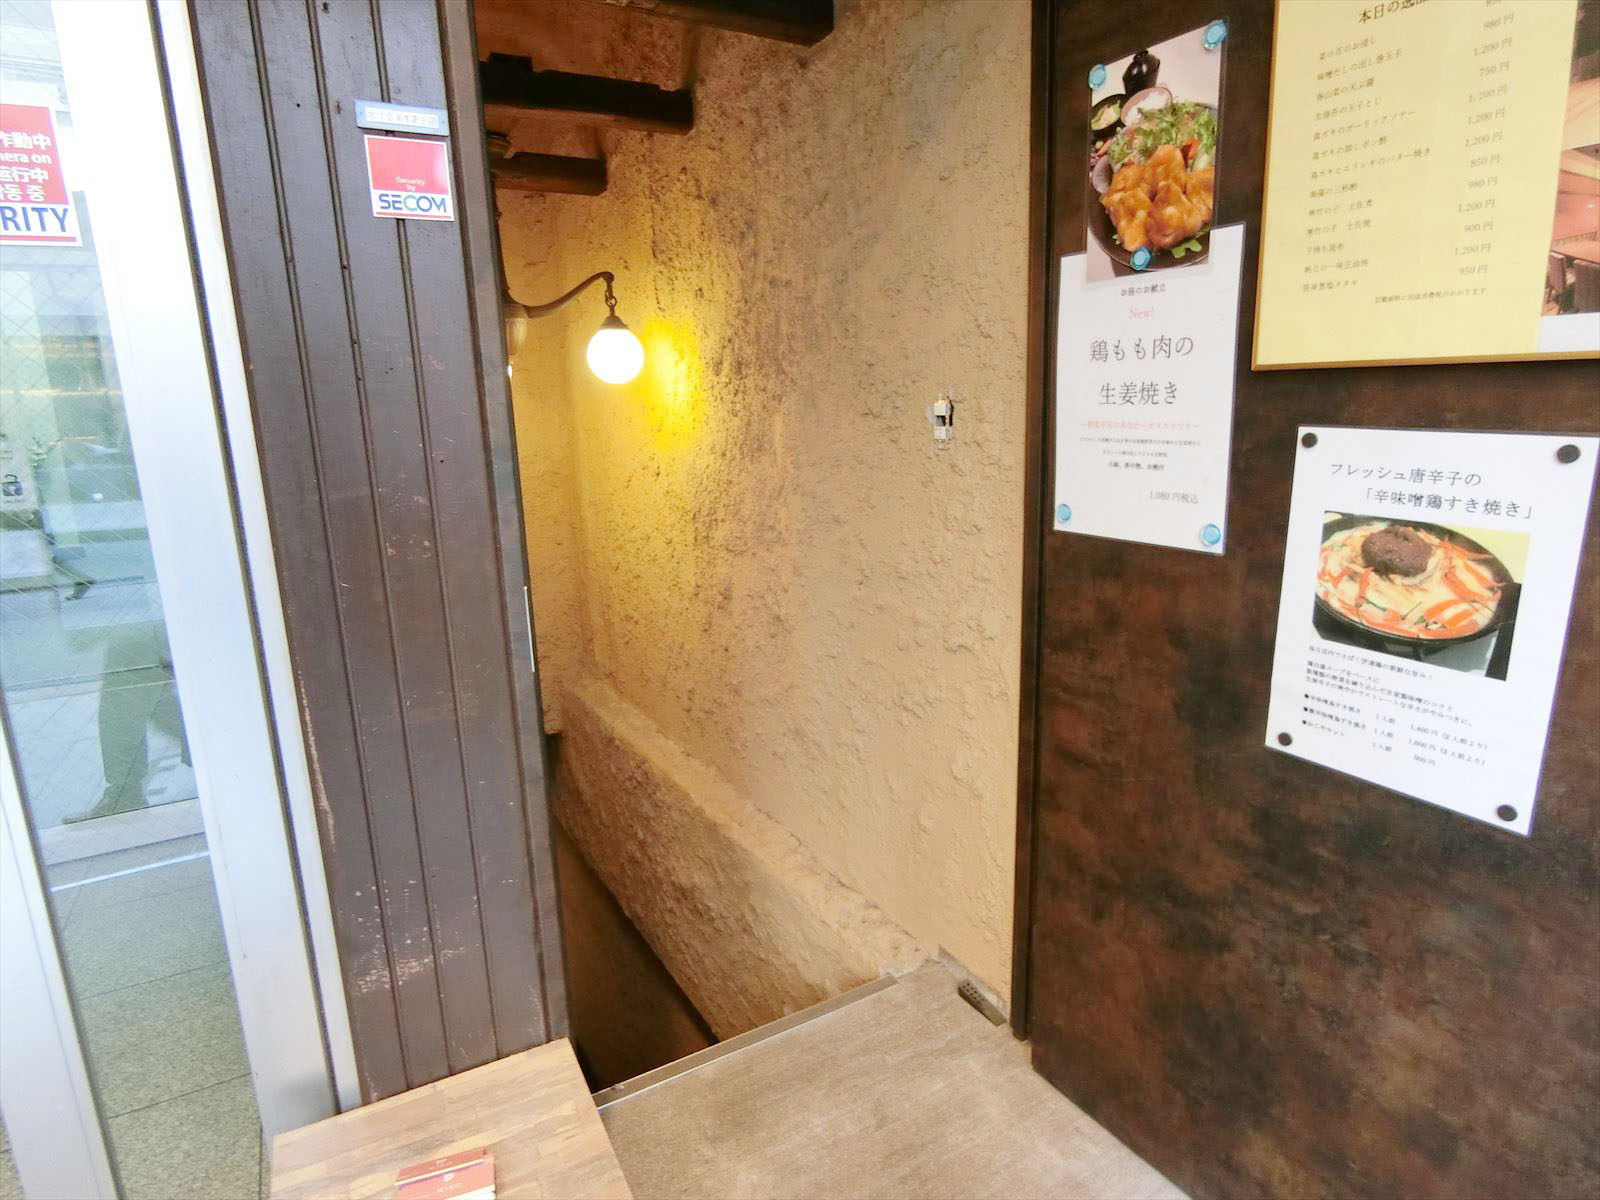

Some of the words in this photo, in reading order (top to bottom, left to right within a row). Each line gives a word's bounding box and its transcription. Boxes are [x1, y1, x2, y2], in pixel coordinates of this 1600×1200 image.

[32, 153, 53, 165] on
[396, 176, 425, 186] Security
[407, 184, 416, 192] by
[379, 193, 447, 213] SECOM
[0, 206, 69, 232] RITY
[1121, 284, 1167, 297] お昼のお献立
[1129, 307, 1155, 320] New!
[1089, 335, 1194, 363] 鶏もも肉の
[1098, 381, 1178, 406] 生姜焼き
[1330, 463, 1482, 487] フレッシュ唐辛子の
[1365, 487, 1533, 520] 「辛味噌鶏すき焼き」
